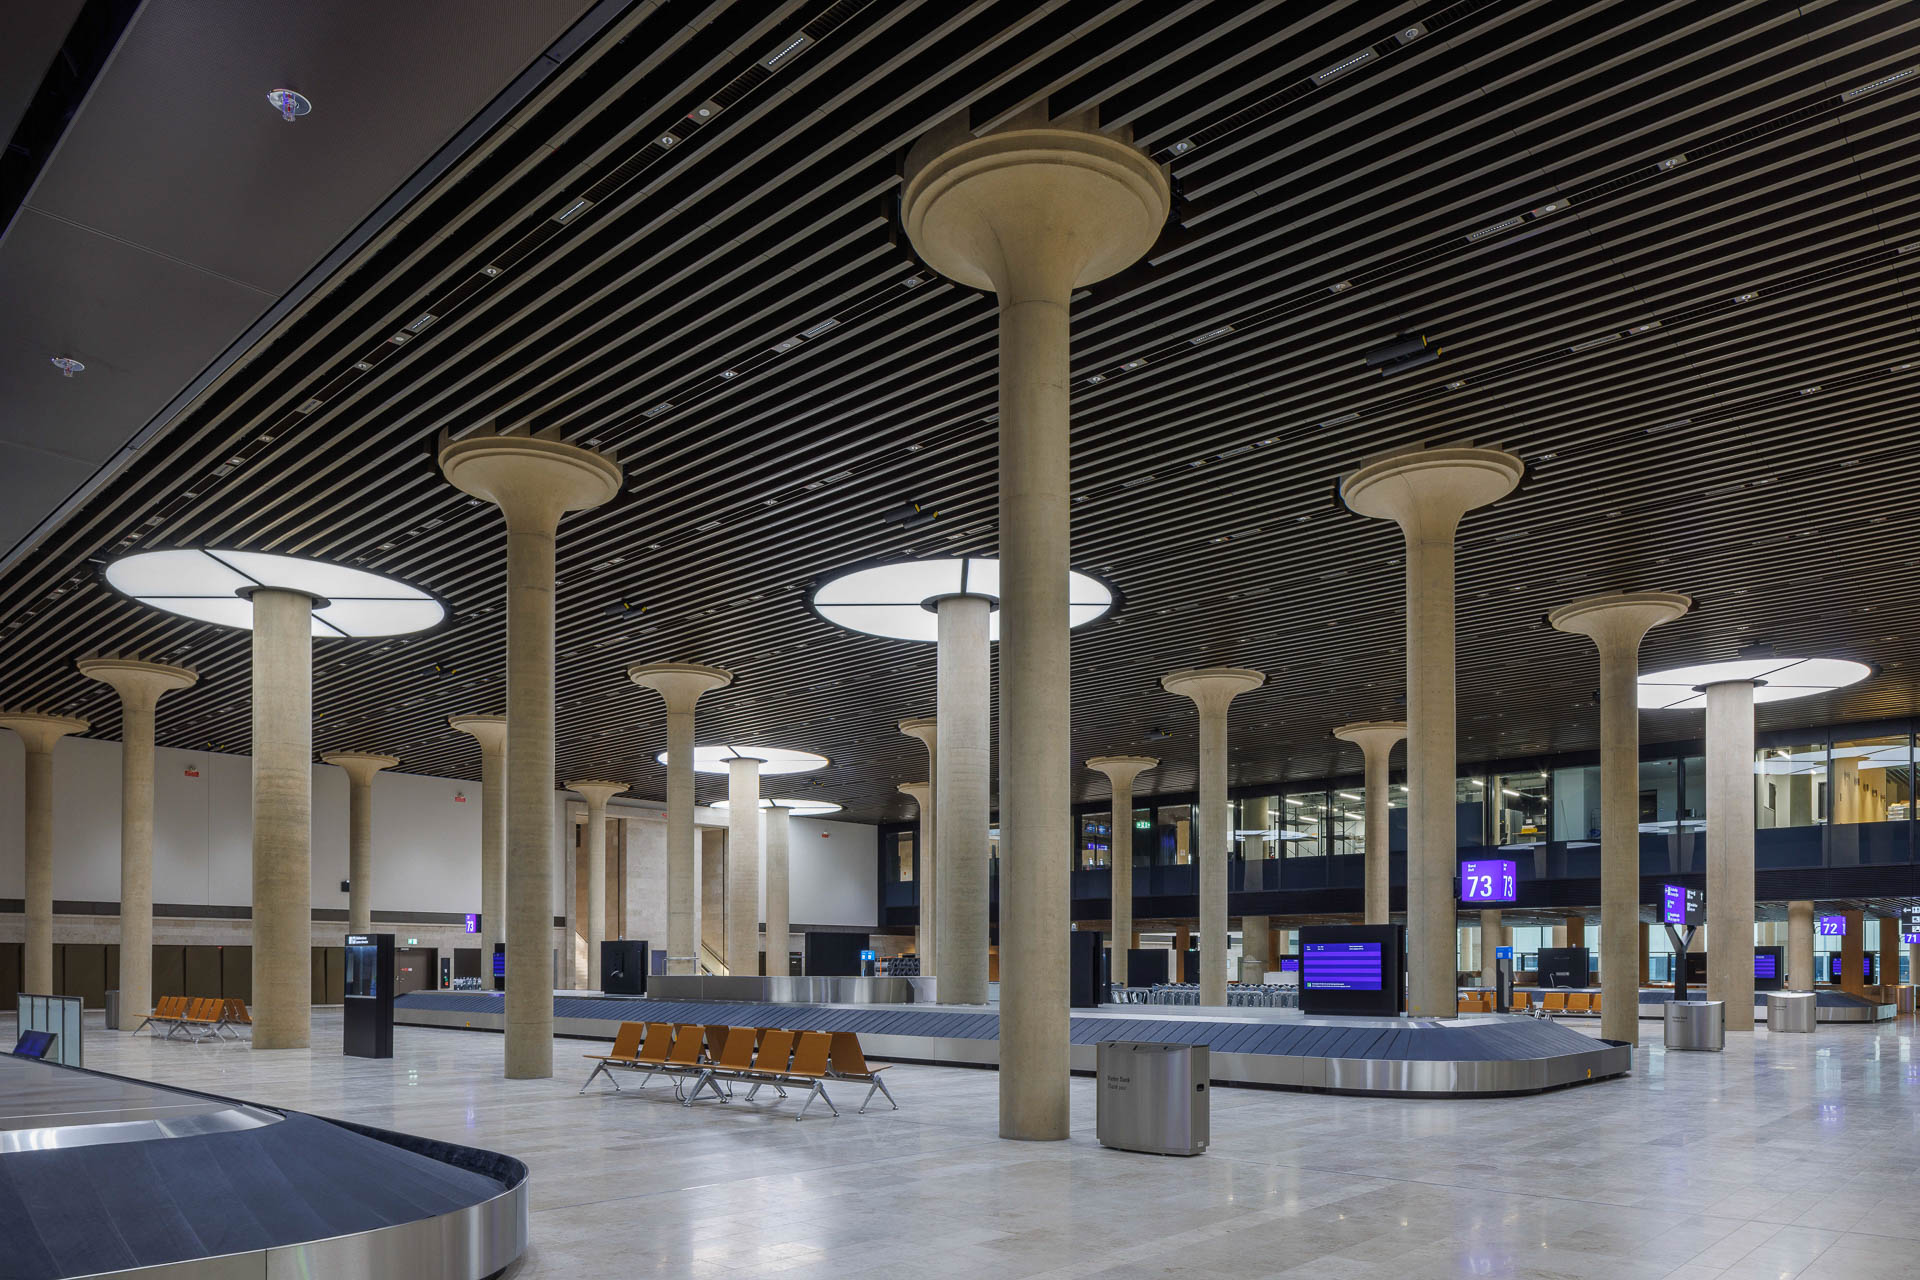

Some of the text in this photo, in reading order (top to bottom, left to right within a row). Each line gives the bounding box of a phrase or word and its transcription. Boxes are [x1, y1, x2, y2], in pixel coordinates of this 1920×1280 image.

[1467, 875, 1492, 897] 73
[1504, 875, 1512, 897] 73
[467, 920, 474, 932] 73
[1823, 923, 1838, 934] 72
[1906, 934, 1917, 943] 71
